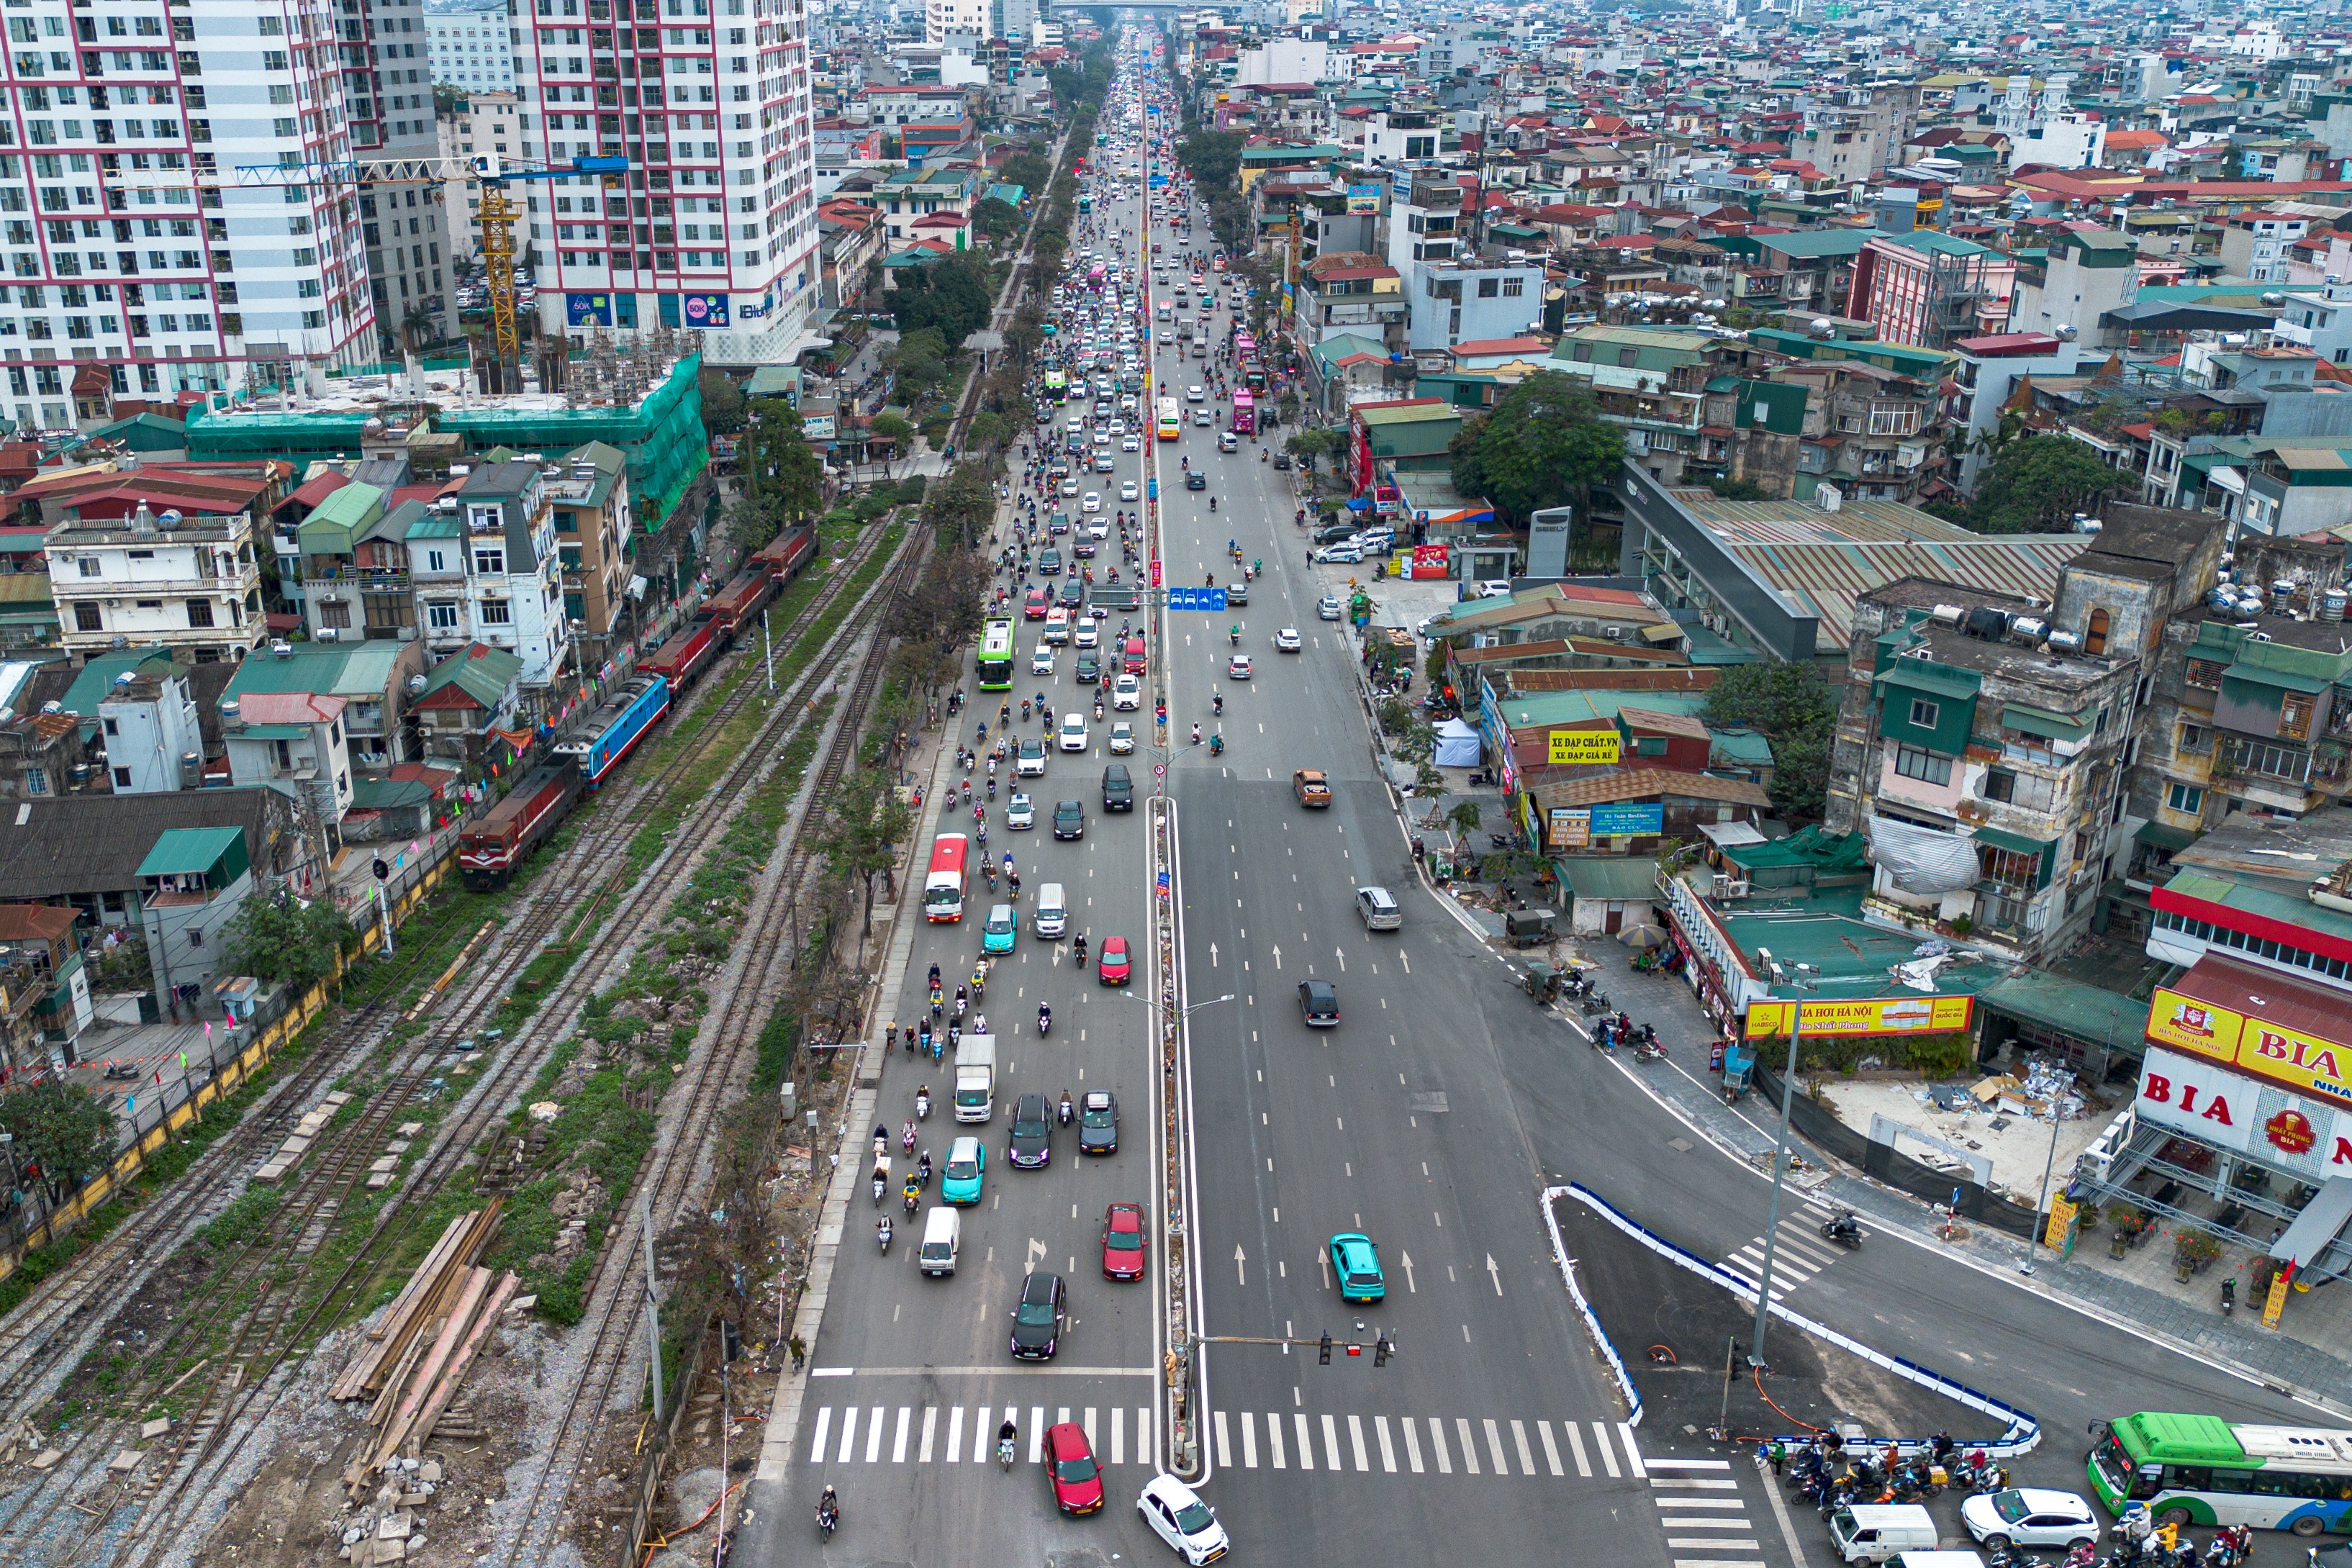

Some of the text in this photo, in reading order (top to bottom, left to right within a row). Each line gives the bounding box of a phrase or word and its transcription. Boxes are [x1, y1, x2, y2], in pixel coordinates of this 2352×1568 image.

[1552, 734, 1618, 750] XE ĐẠP CHẤT.VN
[1568, 752, 1584, 761] ĐẠP
[1586, 750, 1600, 759] GIÁ
[1837, 1005, 1851, 1016] HÀ
[1853, 1005, 1873, 1018] NỘI
[1838, 1020, 1869, 1030] Phong
[2179, 1024, 2203, 1035] HABECO
[2255, 1029, 2343, 1080] BIA
[2313, 1079, 2352, 1098] NHÀ
[2143, 1073, 2233, 1125] BIA
[2280, 1136, 2295, 1146] BIA
[2287, 1130, 2310, 1143] PHONG
[2055, 1206, 2070, 1218] BIA
